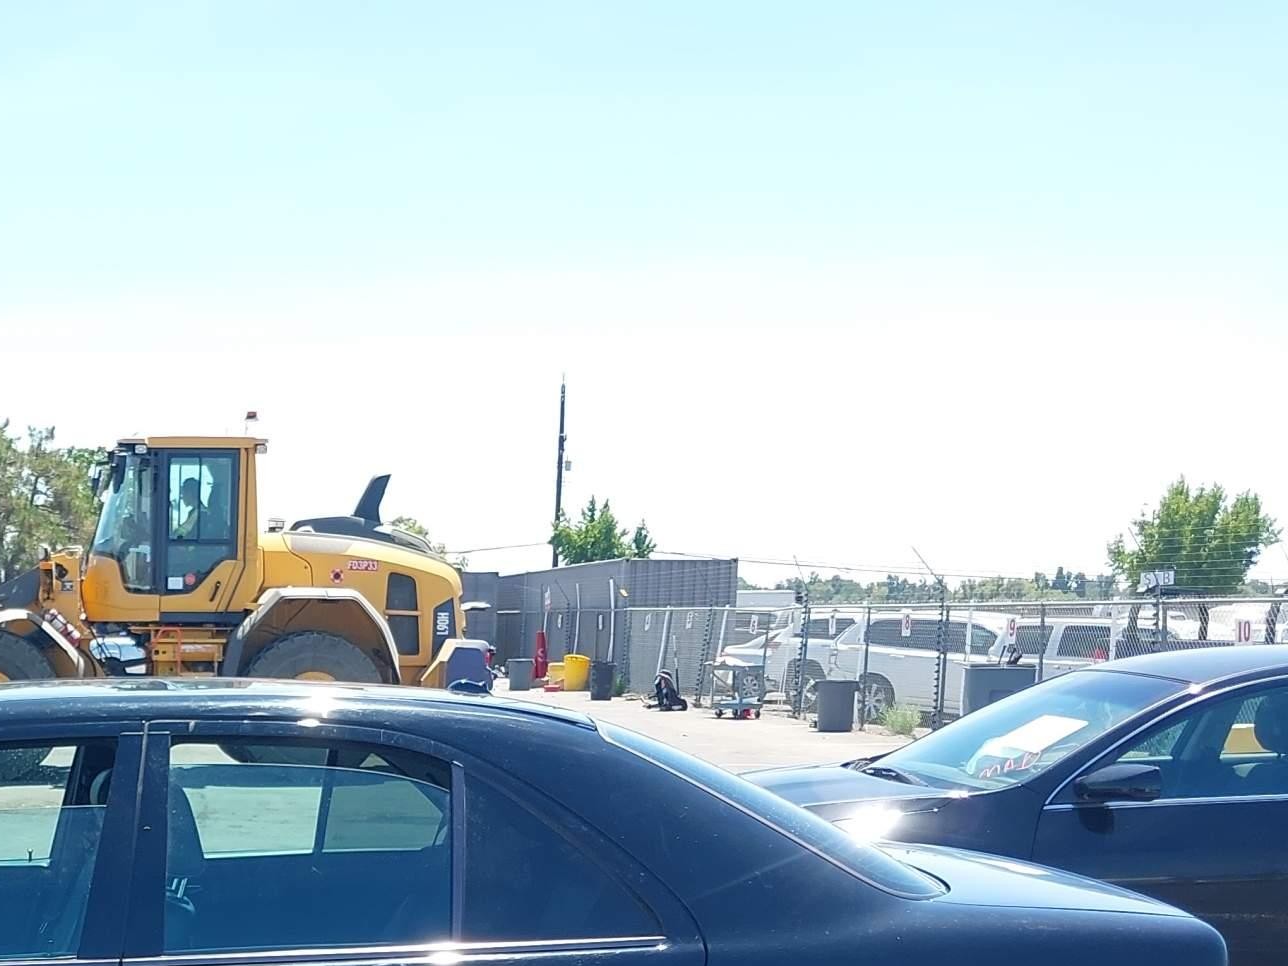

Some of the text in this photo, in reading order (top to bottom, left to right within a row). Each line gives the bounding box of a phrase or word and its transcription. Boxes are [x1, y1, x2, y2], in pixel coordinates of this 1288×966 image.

[1163, 571, 1170, 584] B
[436, 612, 450, 635] L90H
[904, 614, 910, 630] 8
[1009, 618, 1016, 637] 9
[1238, 621, 1251, 643] 10
